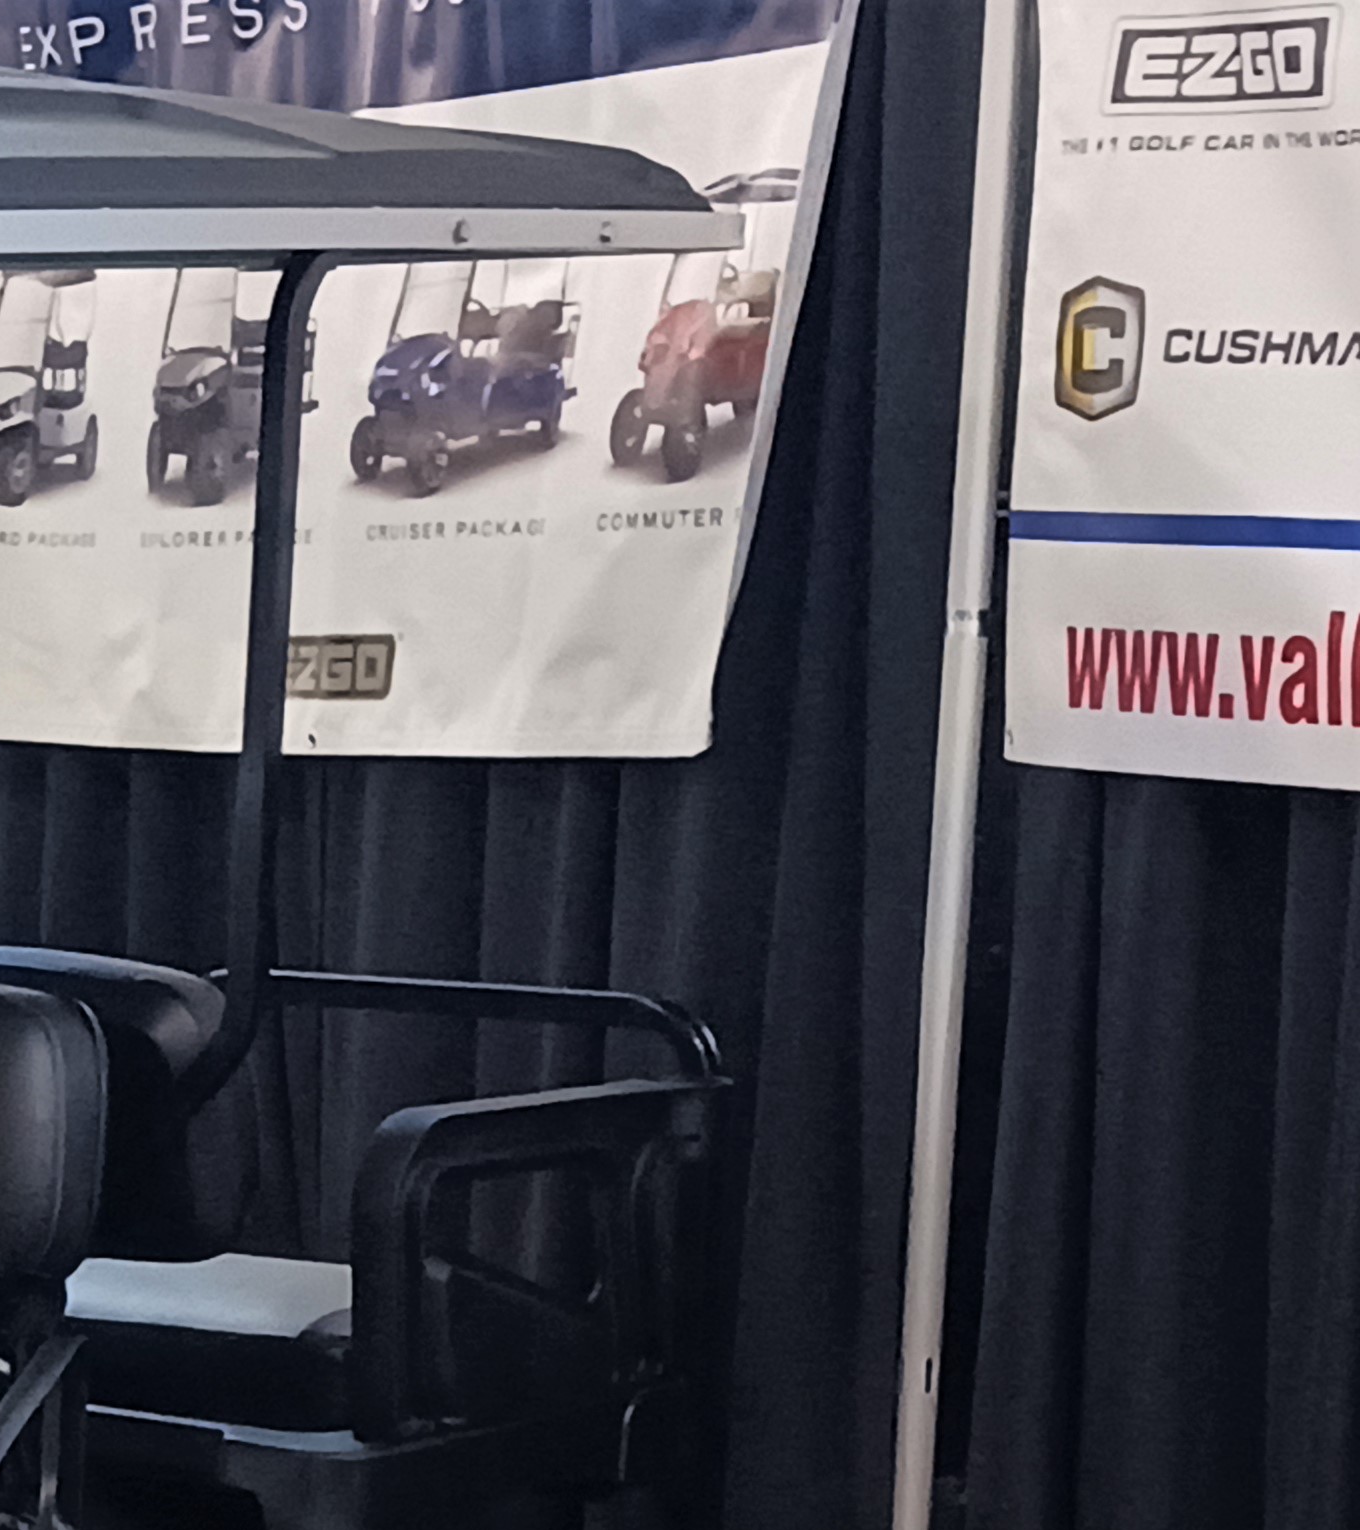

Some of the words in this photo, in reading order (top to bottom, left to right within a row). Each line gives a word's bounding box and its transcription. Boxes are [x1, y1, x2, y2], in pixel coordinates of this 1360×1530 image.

[1121, 25, 1319, 99] EZGO
[1129, 135, 1194, 151] GOLF
[1204, 134, 1253, 151] CAR
[1262, 134, 1279, 149] IN
[596, 506, 723, 533] COMMUTER
[285, 643, 389, 691] ZGO
